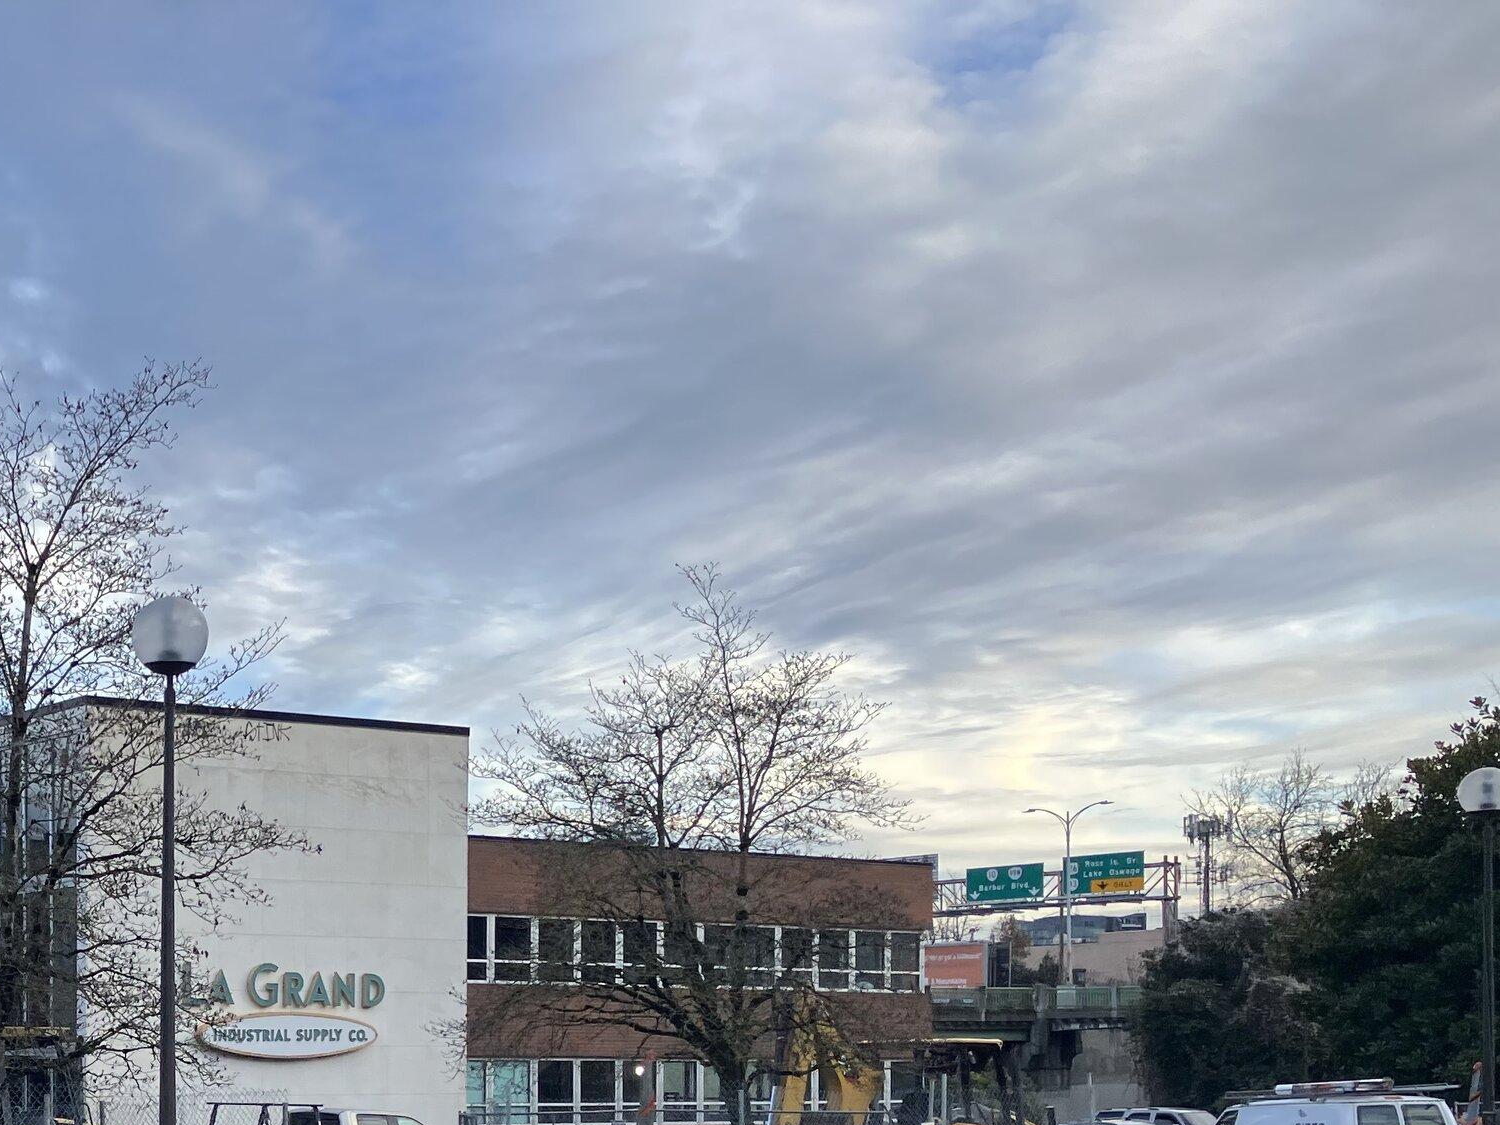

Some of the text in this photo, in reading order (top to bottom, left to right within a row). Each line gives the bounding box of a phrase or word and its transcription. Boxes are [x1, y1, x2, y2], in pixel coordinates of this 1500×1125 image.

[1084, 860, 1104, 868] Ross
[1083, 870, 1103, 878] Lake
[213, 1028, 369, 1043] INDUSTRIAL SUPPLY CO.
